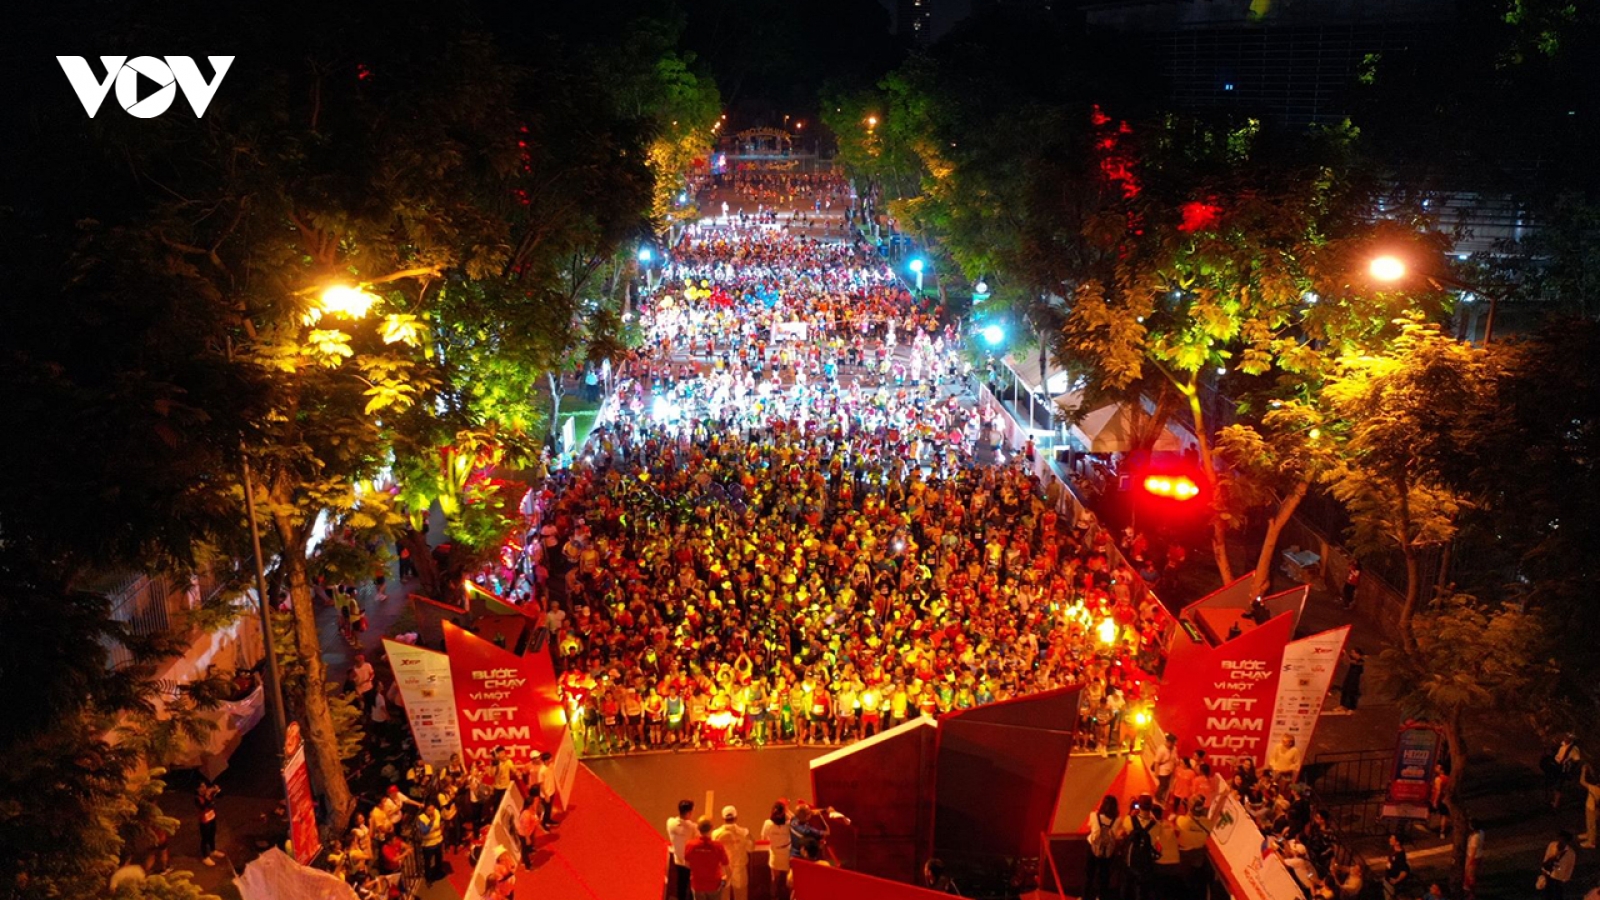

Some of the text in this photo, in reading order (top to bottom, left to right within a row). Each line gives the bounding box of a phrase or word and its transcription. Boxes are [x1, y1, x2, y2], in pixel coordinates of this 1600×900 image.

[1221, 660, 1266, 670] BƯỚC
[471, 667, 518, 679] BƯỚC
[1230, 670, 1273, 681] CHẠY
[484, 678, 526, 690] CHẠY
[1226, 682, 1255, 691] MỘT
[483, 691, 511, 701] MỘT
[1203, 694, 1257, 715] VIỆT
[463, 704, 518, 725] VIỆT
[1206, 717, 1264, 731] NAM
[472, 726, 530, 741] NAM
[1196, 734, 1260, 752] VƯỢT
